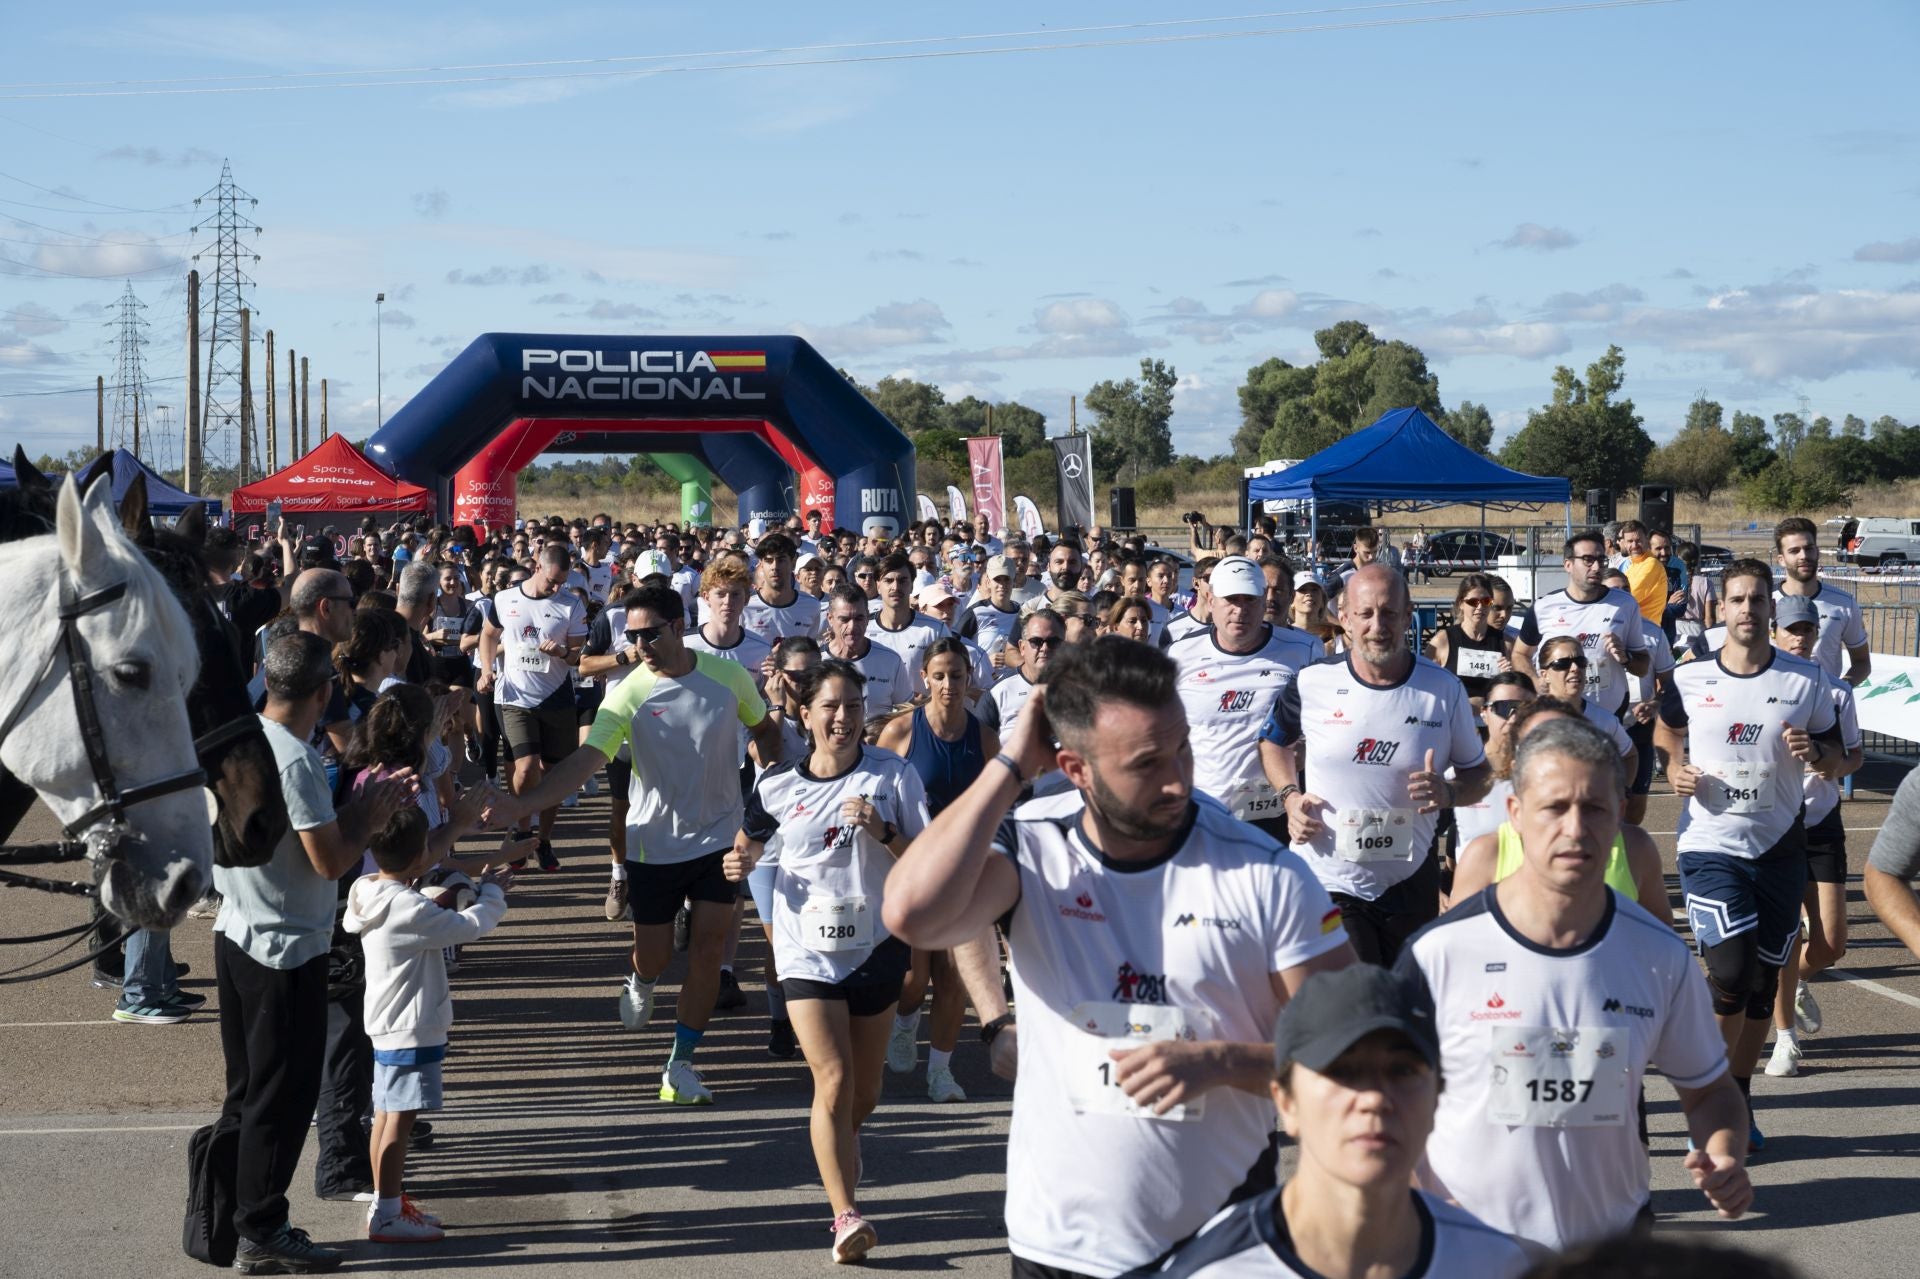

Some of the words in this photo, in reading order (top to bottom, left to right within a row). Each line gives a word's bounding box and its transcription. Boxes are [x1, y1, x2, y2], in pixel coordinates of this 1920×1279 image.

[522, 376, 766, 400] NACIONAL
[313, 465, 355, 475] Sports
[307, 476, 376, 486] Santander
[469, 480, 501, 491] Sports
[243, 496, 268, 505] Sports
[336, 496, 362, 505] Sports
[466, 494, 513, 505] Santander
[861, 488, 899, 513] RUTA
[1469, 662, 1490, 671] 1481
[1723, 788, 1758, 800] 1461
[1248, 798, 1278, 811] 1574
[1355, 835, 1393, 849] 1069
[819, 925, 855, 938] 1280
[1470, 1010, 1522, 1021] Santander
[1526, 1080, 1595, 1103] 1587
